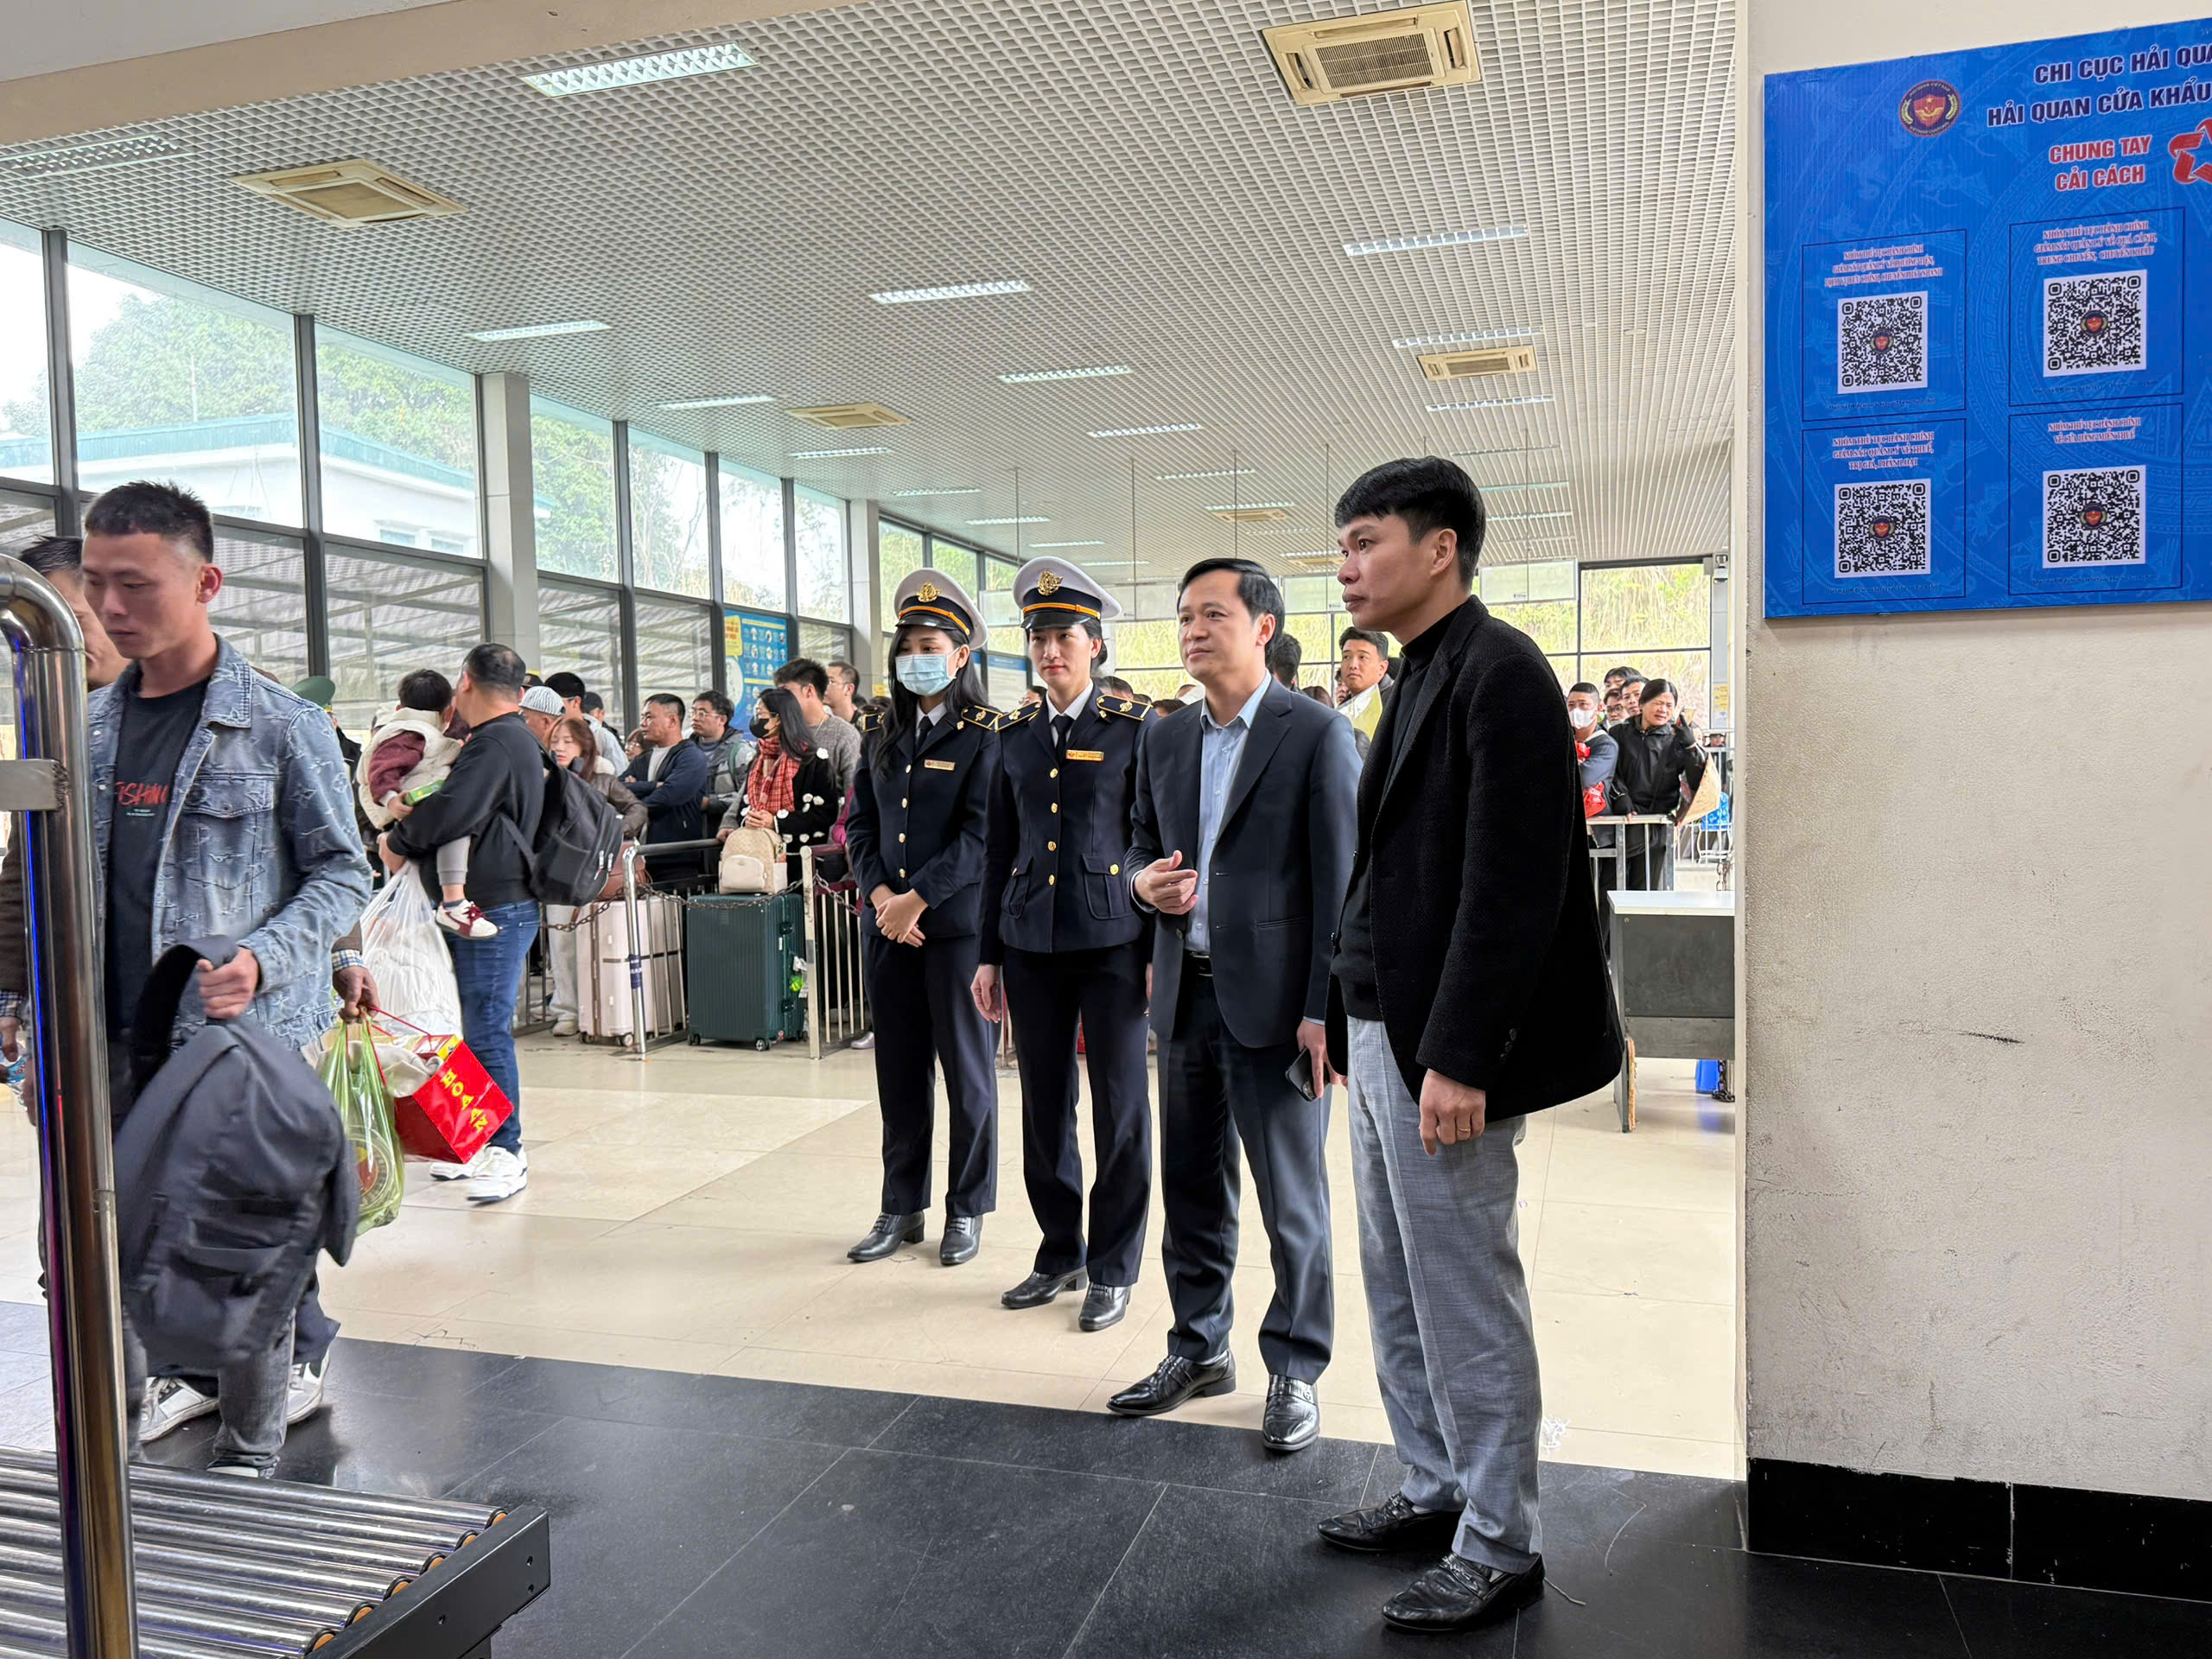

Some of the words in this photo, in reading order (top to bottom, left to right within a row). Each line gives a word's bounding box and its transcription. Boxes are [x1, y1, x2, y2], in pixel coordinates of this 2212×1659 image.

[2034, 62, 2072, 85] CHI
[2079, 55, 2124, 81] CỤC
[2131, 45, 2169, 73] HẢI
[1987, 99, 2025, 128] HẢI
[2031, 97, 2091, 124] QUAN
[2097, 87, 2144, 114] CỬA
[2149, 77, 2212, 109] KHẨU
[2049, 139, 2115, 164] CHUNG
[2120, 135, 2152, 156] TAY
[2055, 166, 2088, 192] CẢI
[2093, 163, 2145, 188] CÁCH
